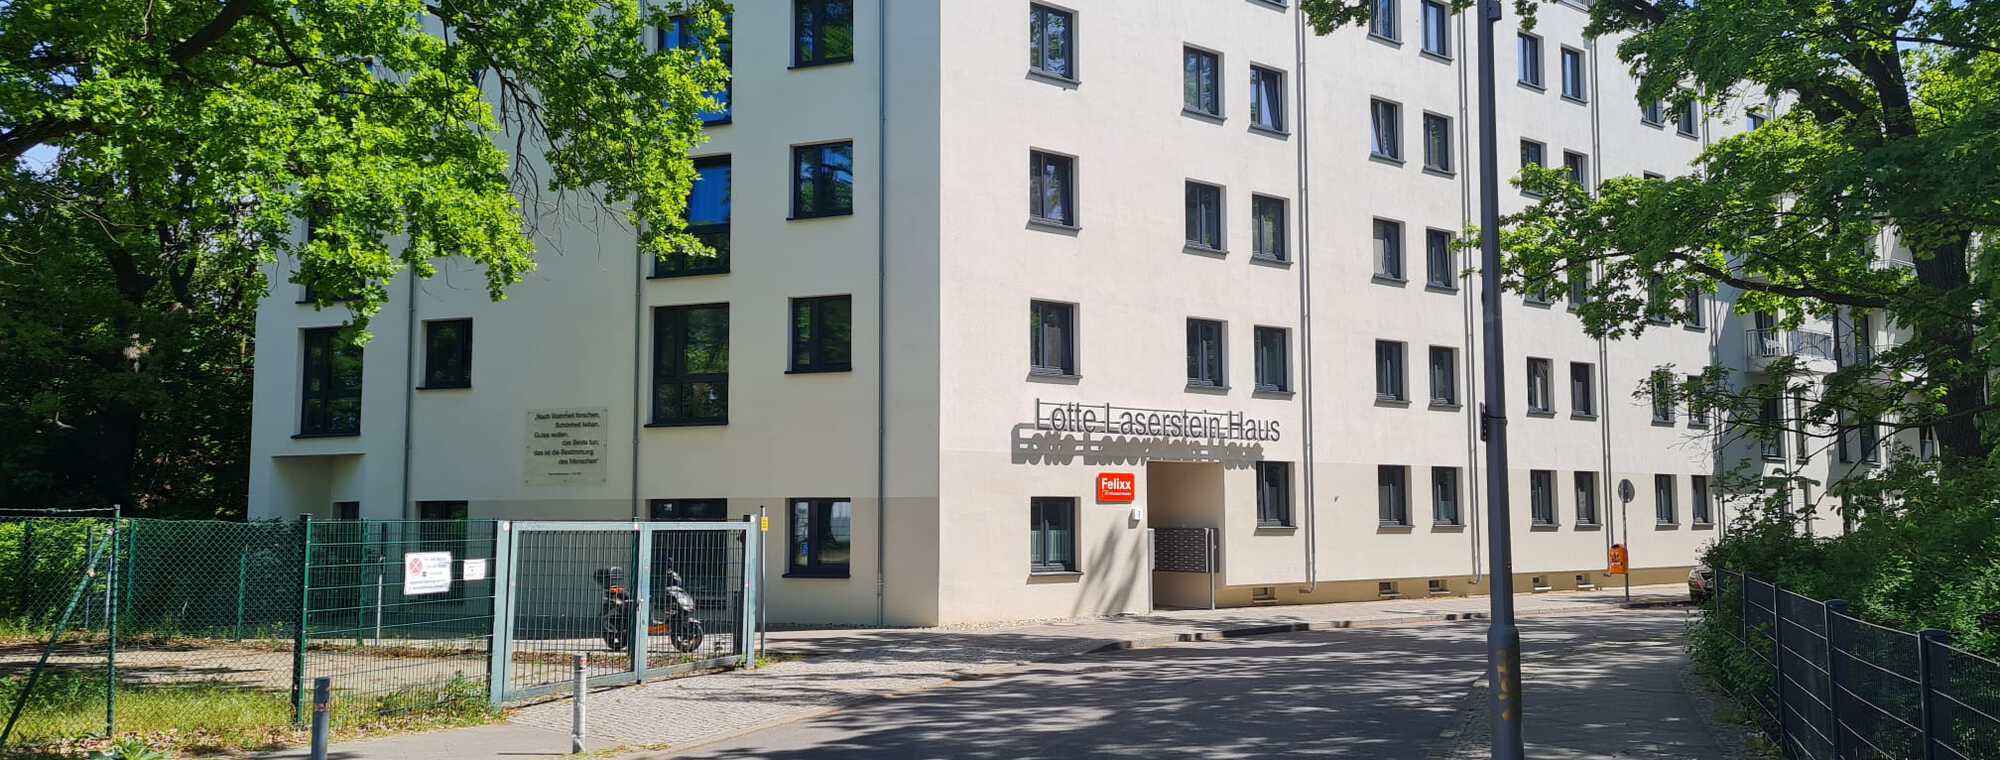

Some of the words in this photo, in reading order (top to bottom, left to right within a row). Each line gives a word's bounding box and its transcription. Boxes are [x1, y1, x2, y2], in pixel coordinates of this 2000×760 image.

[1036, 398, 1097, 434] Lotte
[1106, 402, 1220, 439] Laserstein
[1228, 410, 1281, 442] Haus
[1101, 477, 1132, 490] Felixx
